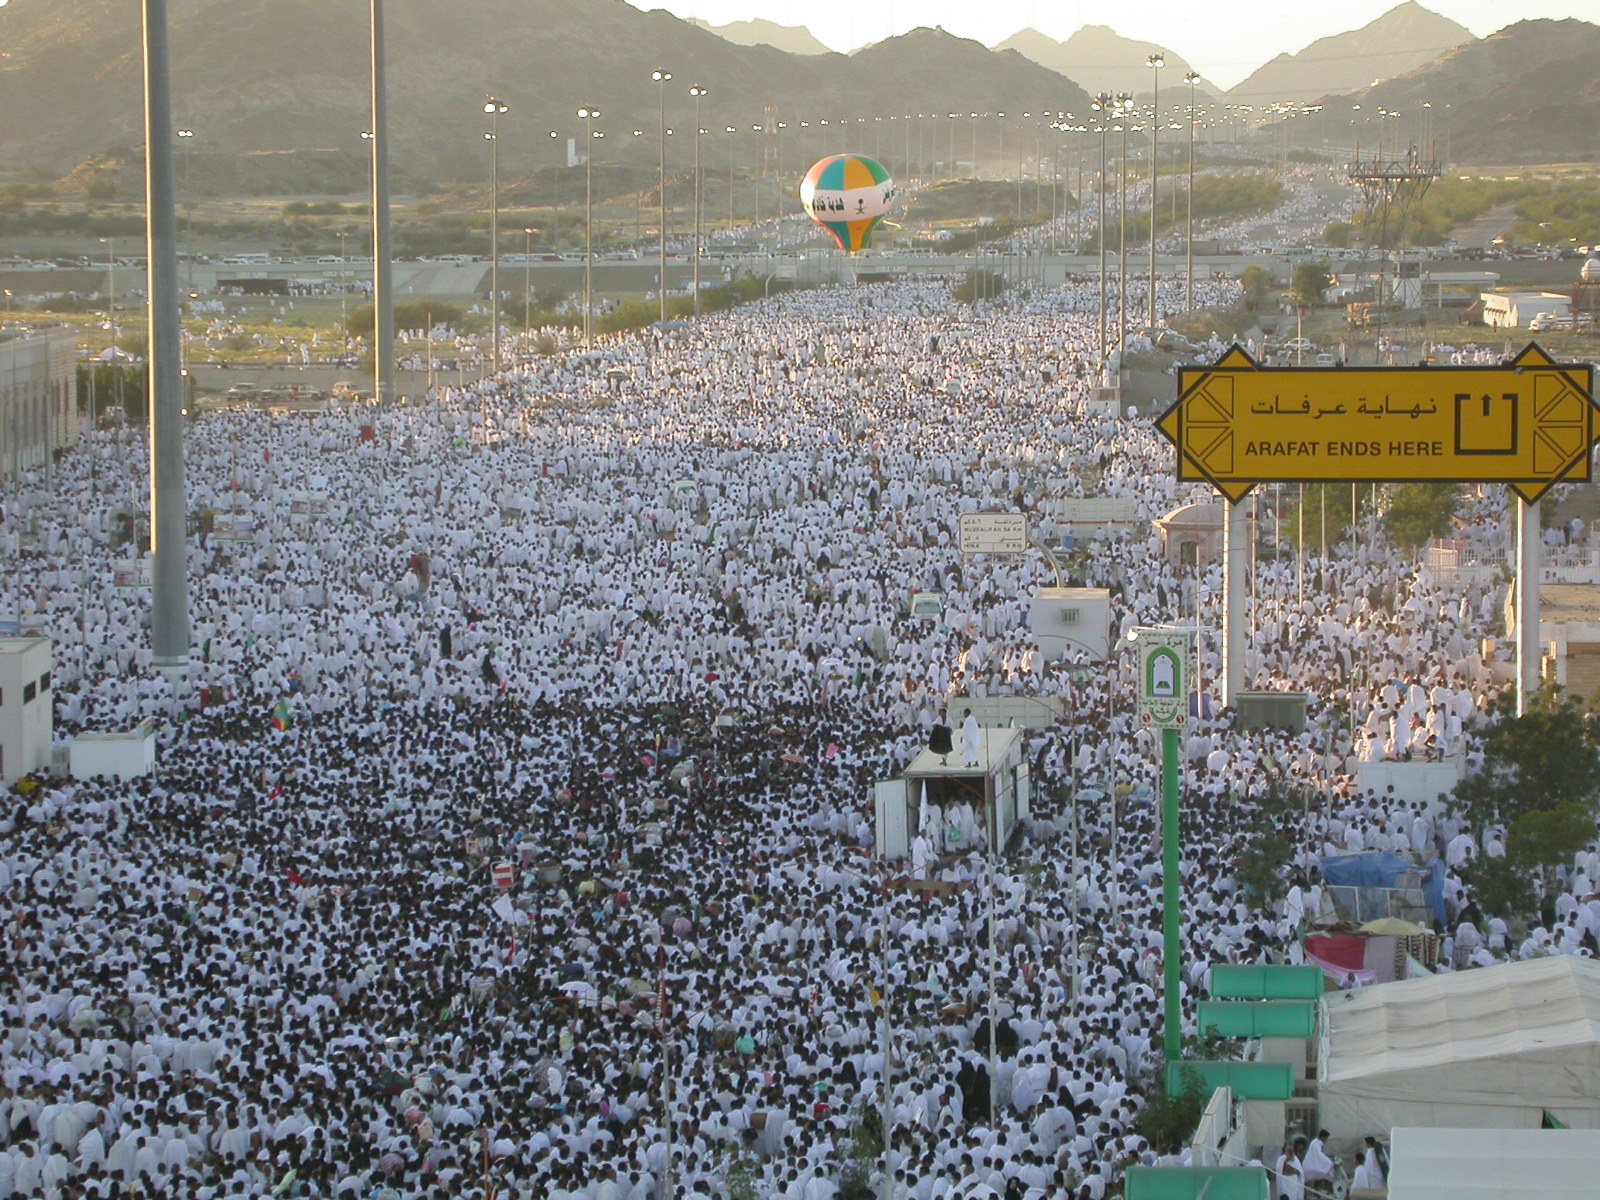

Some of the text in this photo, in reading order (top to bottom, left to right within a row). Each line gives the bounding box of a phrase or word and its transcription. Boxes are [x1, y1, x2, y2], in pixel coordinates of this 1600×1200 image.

[1250, 394, 1438, 420] نهاية عرفات
[1244, 441, 1443, 457] ARAFAT ENDS HERE
